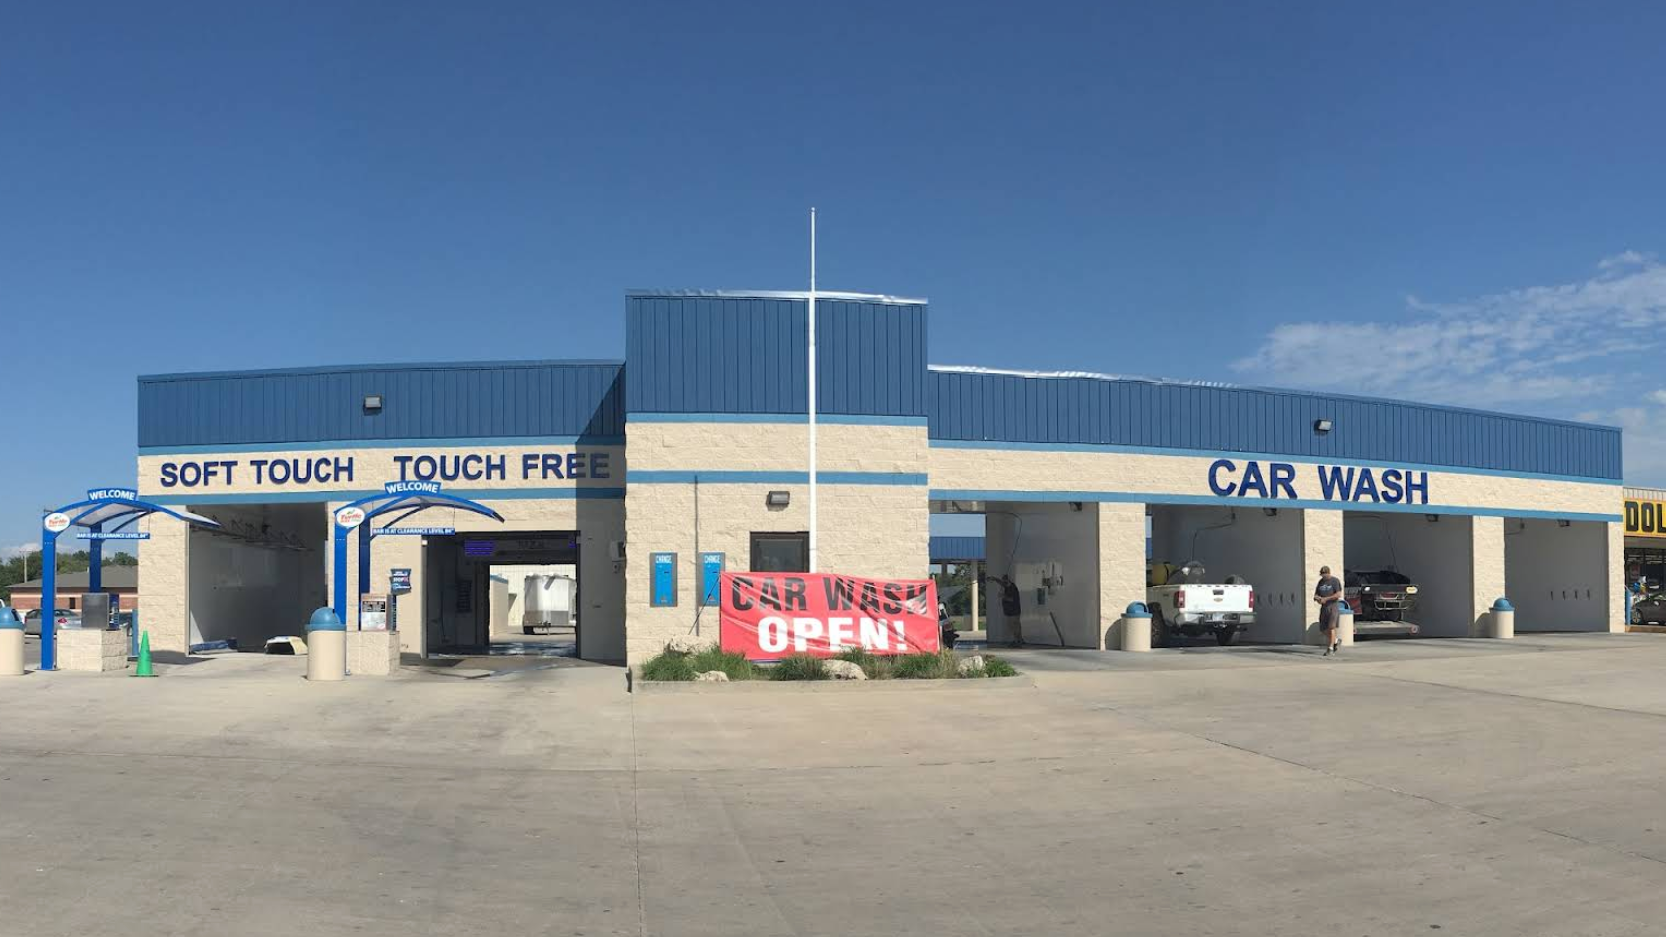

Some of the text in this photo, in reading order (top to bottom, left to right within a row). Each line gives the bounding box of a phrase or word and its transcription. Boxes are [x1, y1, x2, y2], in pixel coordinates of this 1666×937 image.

[160, 457, 353, 487] SOFT TOUCH
[393, 453, 610, 481] TOUCH FREE
[1208, 459, 1428, 504] CAR WASH
[89, 489, 135, 500] WELCOME
[386, 482, 438, 494] WELCOME
[731, 576, 928, 615] CAR WASH
[757, 616, 909, 653] OPEN!
